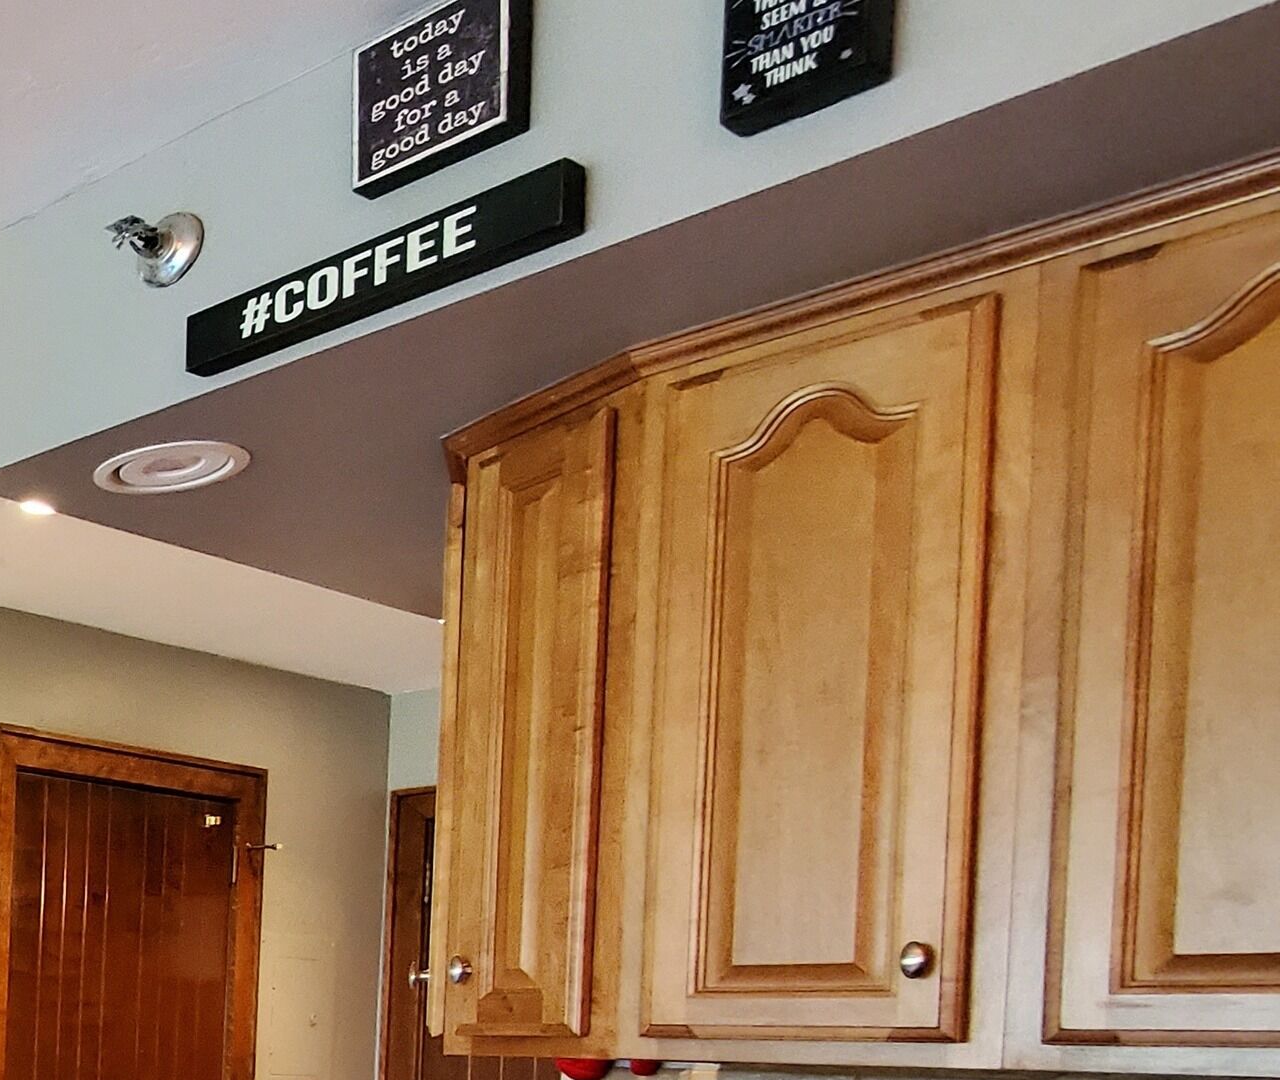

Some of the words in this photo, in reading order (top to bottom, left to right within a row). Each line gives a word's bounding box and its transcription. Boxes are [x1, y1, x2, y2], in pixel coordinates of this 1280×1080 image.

[390, 8, 466, 58] today
[747, 1, 842, 55] SMARTER
[760, 0, 807, 30] SEEM
[401, 53, 429, 80] is
[436, 43, 453, 61] a
[750, 42, 794, 74] THAN
[800, 24, 834, 53] YOU
[764, 52, 819, 88] THINK
[371, 74, 431, 123] good
[438, 50, 486, 84] day
[393, 99, 437, 133] for
[444, 89, 461, 107] a
[370, 123, 431, 171] good
[438, 101, 486, 134] day
[239, 205, 477, 339] #COFFEE
